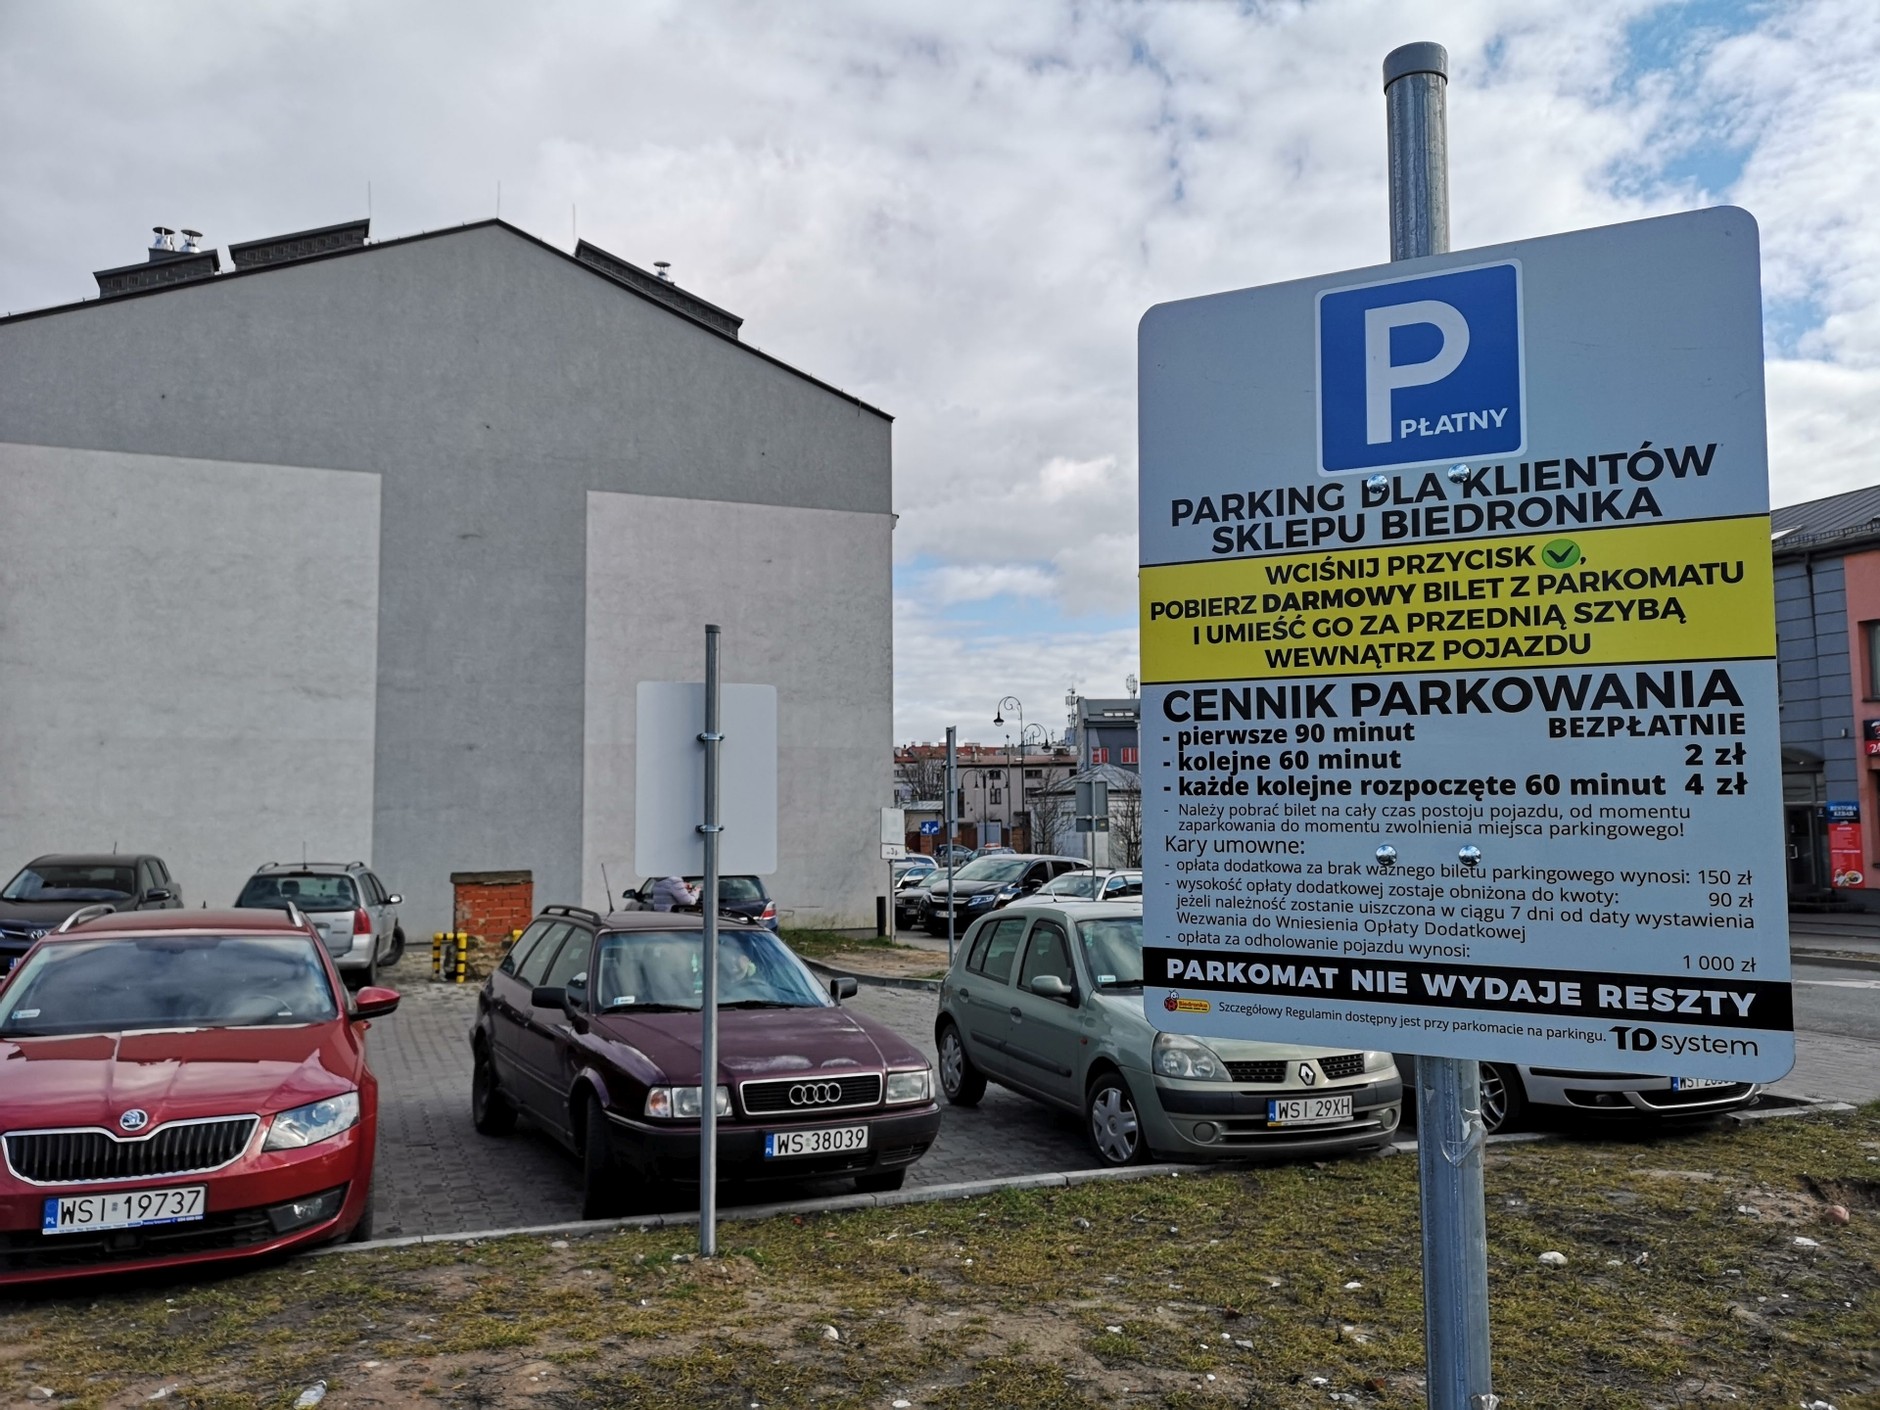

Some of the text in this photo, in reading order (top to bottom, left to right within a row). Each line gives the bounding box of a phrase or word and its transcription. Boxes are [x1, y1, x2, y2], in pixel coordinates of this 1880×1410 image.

[1364, 299, 1471, 446] P
[1400, 407, 1508, 439] PŁATNY
[1171, 440, 1718, 527] PARKING DLA KLIENTÓW
[1211, 486, 1664, 555] SKLEPU BIEDRONKA
[1264, 555, 1381, 586] WCIŚNIJ
[1387, 545, 1537, 577] PRZYCISK
[1150, 560, 1744, 621] POBIERZ DARMOWY BILET Z PARKOMATU
[1193, 596, 1687, 645] I UMIEŚĆ GO ZA PRZEDNIĄ SZYBĄ
[1264, 632, 1592, 669] WEWNĄTRZ POJAZDU
[1162, 668, 1744, 723] CENNIK PARKOWANIA
[1178, 725, 1288, 751] pierwsze
[1295, 723, 1325, 743] 90
[1333, 720, 1415, 743] minut
[1549, 712, 1746, 739] BEZPŁATNIE
[1178, 749, 1271, 777] kolejne
[1279, 750, 1309, 770] 60
[1318, 748, 1402, 770] minut
[1684, 743, 1703, 766] 2
[1714, 741, 1747, 766] zł
[1178, 775, 1249, 796] każde
[1257, 774, 1352, 802] kolejne
[1361, 775, 1517, 802] rozpoczęte
[1525, 773, 1560, 796] 60
[1570, 772, 1667, 796] minut
[1684, 773, 1704, 795] 4
[1716, 771, 1748, 795] zł
[1178, 803, 1224, 819] Należy
[1229, 803, 1279, 819] pobrać
[1284, 803, 1317, 817] bilet
[1321, 805, 1340, 817] na
[1345, 803, 1377, 820] cały
[1381, 806, 1416, 818] czas
[1421, 804, 1484, 821] postoju
[1490, 804, 1563, 821] pojazdu,
[1570, 804, 1592, 818] od
[1600, 805, 1691, 819] momentu
[1178, 818, 1684, 840] zaparkowania do momentu zwolnienia miejsca parkingowego!
[1165, 835, 1305, 857] Kary umowne:
[1176, 858, 1219, 873] opłata
[1224, 858, 1302, 874] dodatkowa
[1306, 863, 1323, 874] za
[1328, 861, 1362, 875] brak
[1440, 863, 1487, 879] biletu
[1492, 865, 1615, 886] parkingowego
[1620, 869, 1690, 887] wynosi:
[1698, 870, 1731, 885] 150
[1737, 870, 1752, 885] zł
[1176, 877, 1242, 893] wysokość
[1246, 879, 1292, 896] opłaty
[1296, 880, 1383, 899] dodatkowej
[1388, 884, 1444, 901] zostaje
[1449, 884, 1526, 901] obniżona
[1532, 886, 1554, 902] do
[1560, 887, 1619, 907] kwoty:
[1708, 892, 1732, 907] 90
[1738, 892, 1754, 908] zł
[1176, 894, 1754, 930] jeżeli należność zostanie uiszczona w ciągu 7 dni od daty wystawienia
[1176, 911, 1526, 943] Wezwania do Wniesienia Opłaty Dodatkowej
[1177, 931, 1220, 946] opłata
[1225, 934, 1240, 945] za
[1244, 933, 1338, 950] odholowanie
[1343, 939, 1404, 955] pojazdu
[1408, 944, 1471, 959] wynosi:
[1741, 957, 1756, 973] zł
[1166, 958, 1757, 1017] PARKOMAT NIE WYDAJE RESZTY
[1218, 1001, 1607, 1044] Szczegółowy Regulamin dostępny jest przy parkomacie na parkingu.
[1608, 1025, 1759, 1057] TD system
[1279, 1098, 1350, 1119] WSI 29XH
[777, 1128, 865, 1154] WS 38039
[60, 1190, 202, 1225] WSI 19737
